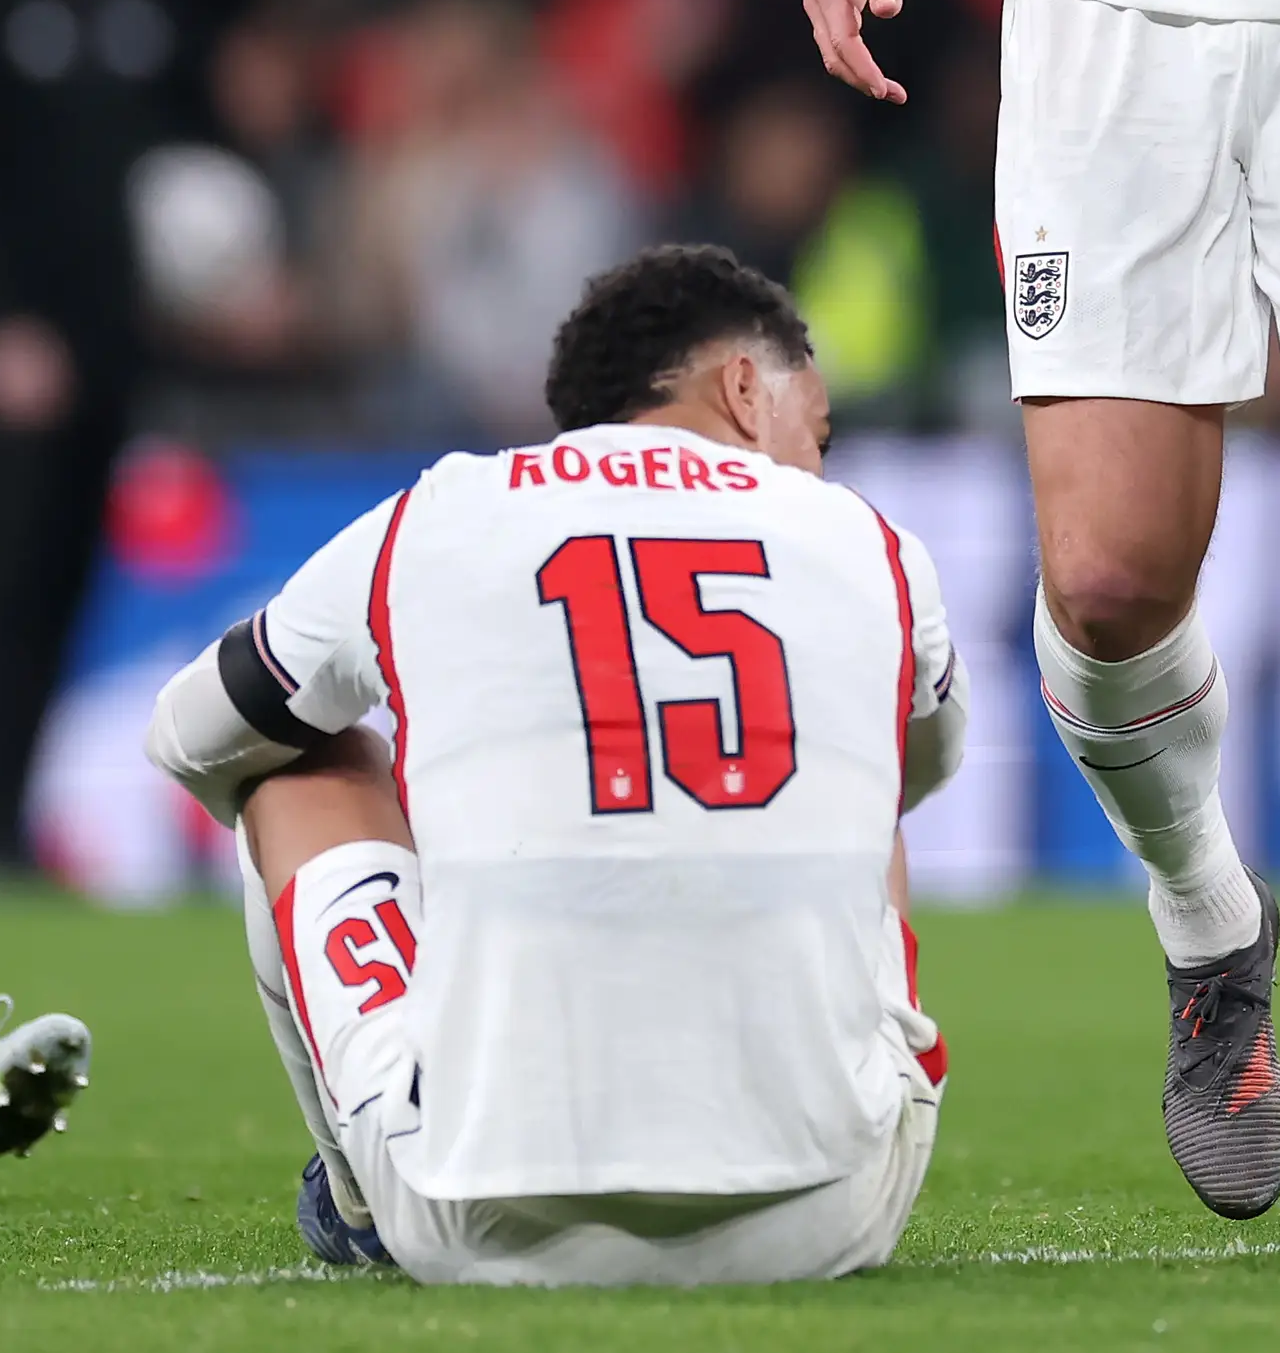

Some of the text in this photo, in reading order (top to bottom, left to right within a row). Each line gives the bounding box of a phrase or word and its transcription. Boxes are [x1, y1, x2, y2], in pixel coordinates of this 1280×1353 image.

[507, 445, 760, 495] ROGERS
[534, 533, 798, 817] 15
[322, 898, 418, 1015] 15
